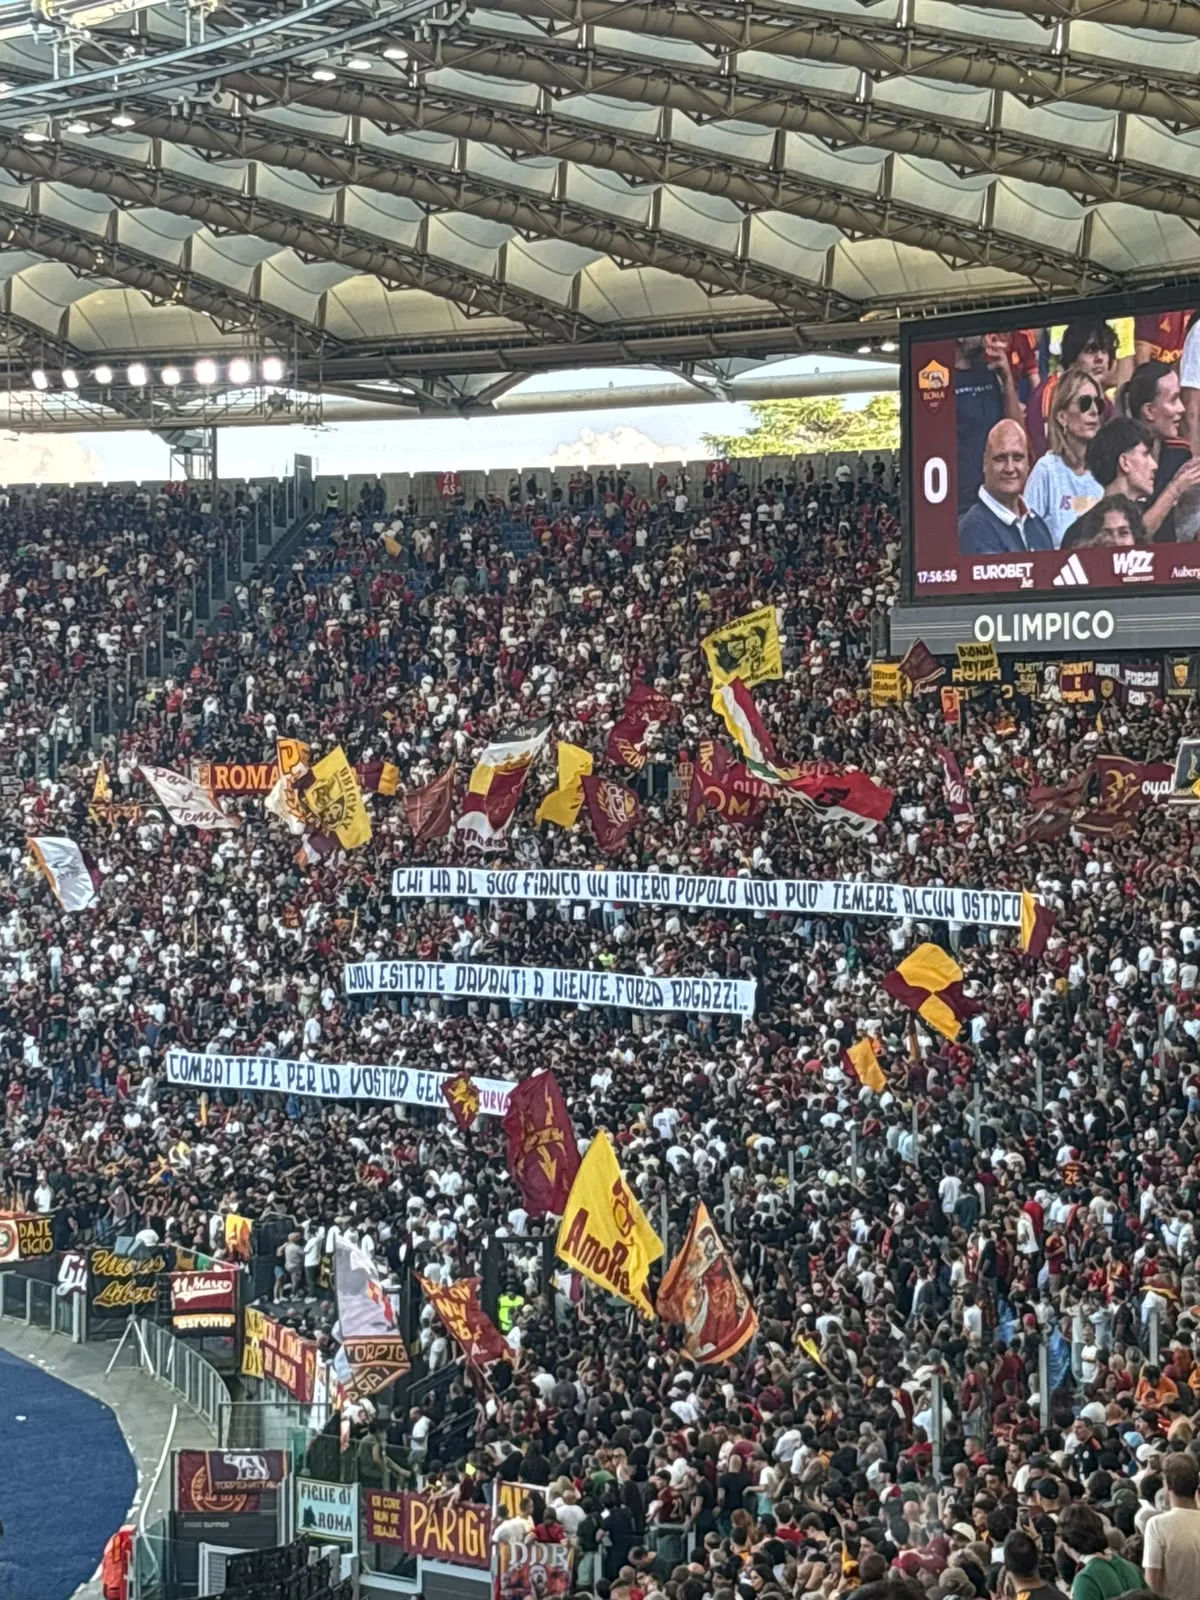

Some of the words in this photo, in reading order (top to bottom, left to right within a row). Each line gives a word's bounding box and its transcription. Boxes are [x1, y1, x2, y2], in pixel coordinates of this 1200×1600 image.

[923, 457, 948, 504] 0
[917, 569, 958, 584] 17:56:56
[972, 562, 1034, 581] EUROBET
[974, 609, 1114, 642] OLIMPICO
[952, 668, 1002, 682] ROMA
[1125, 669, 1159, 687] FORZA
[1141, 772, 1176, 804] oyal
[430, 872, 451, 893] HA
[457, 872, 478, 894] AL
[487, 872, 518, 895] SUO
[587, 874, 609, 898] UN
[676, 877, 737, 905] POPOLO
[745, 882, 777, 907] NON
[833, 883, 898, 913] TEMERE
[904, 888, 955, 918] ALCUN
[962, 892, 1022, 922] OSTACO
[349, 964, 374, 990] NON
[534, 970, 544, 997] A
[169, 1054, 281, 1088] COMBATTETE
[287, 1062, 316, 1092] PER
[321, 1067, 341, 1095] LA
[350, 1067, 409, 1098] VOSTRA
[416, 1072, 446, 1104] GEN
[19, 1219, 52, 1239] DAJE
[318, 1512, 353, 1532] ROMA
[509, 1542, 569, 1572] DDR
